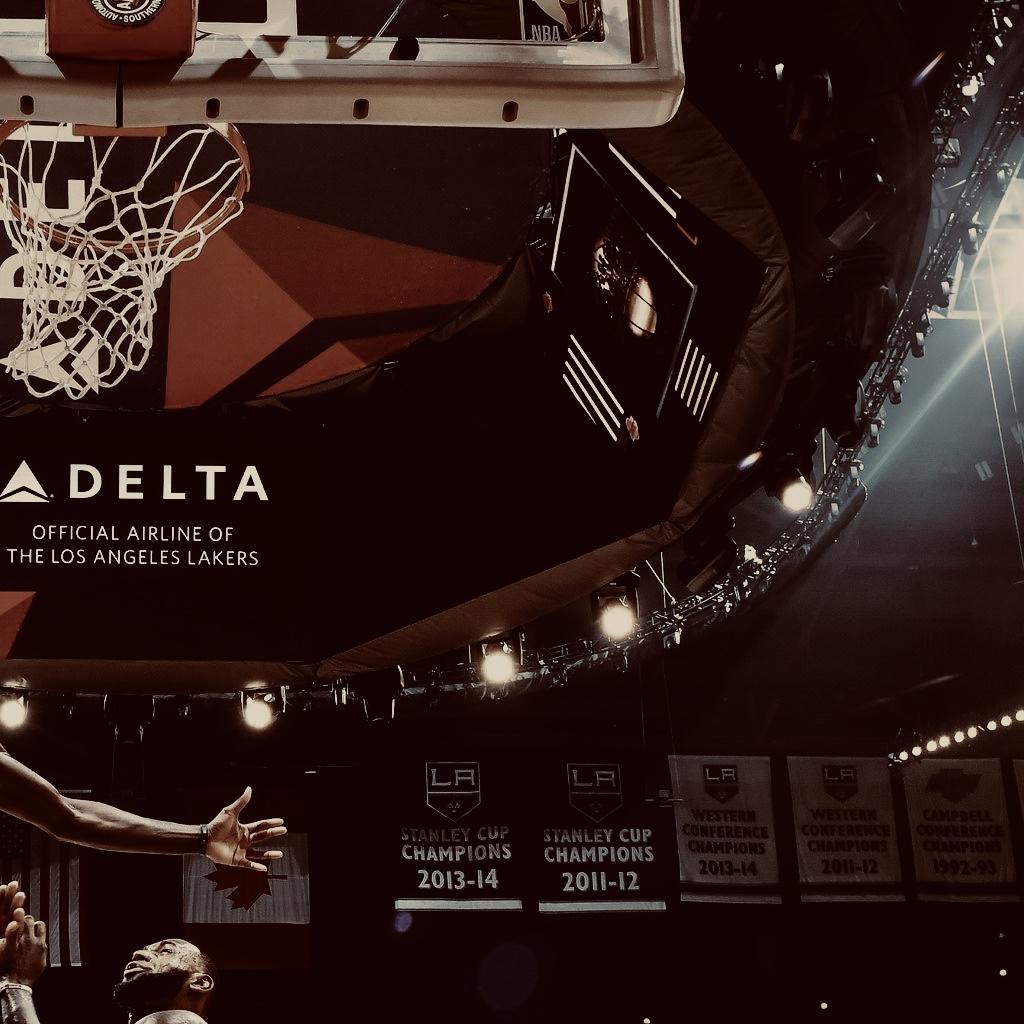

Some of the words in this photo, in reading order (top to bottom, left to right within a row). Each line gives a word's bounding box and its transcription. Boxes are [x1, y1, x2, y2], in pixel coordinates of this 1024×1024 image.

[531, 25, 561, 41] NBA
[69, 463, 269, 501] DELTA
[32, 524, 120, 541] OFFICIAL
[126, 526, 202, 542] AIRLINE
[208, 526, 234, 542] OF
[7, 548, 45, 564] THE
[51, 548, 86, 564] LOS
[93, 549, 180, 565] ANGELES
[187, 550, 259, 566] LAKERS
[430, 768, 476, 787] LA
[571, 769, 616, 787] LA
[690, 809, 757, 823] WESTERN
[809, 808, 877, 822] WESTERN
[400, 827, 471, 843] STANLEY
[477, 825, 511, 841] CUP
[543, 828, 613, 844] STANLEY
[619, 828, 653, 843] CUP
[681, 823, 769, 839] CONFERENCE
[801, 823, 891, 837] CONFERENCE
[401, 843, 513, 862] CHAMPIONS
[544, 846, 655, 863] CHAMPIONS
[687, 839, 766, 855] CHAMPIONS
[807, 839, 888, 853] CHAMPIONS
[698, 859, 759, 876] 2013-14
[820, 858, 879, 874] 2011-12
[417, 868, 499, 890] 2013-14
[561, 871, 641, 892] 2011-12
